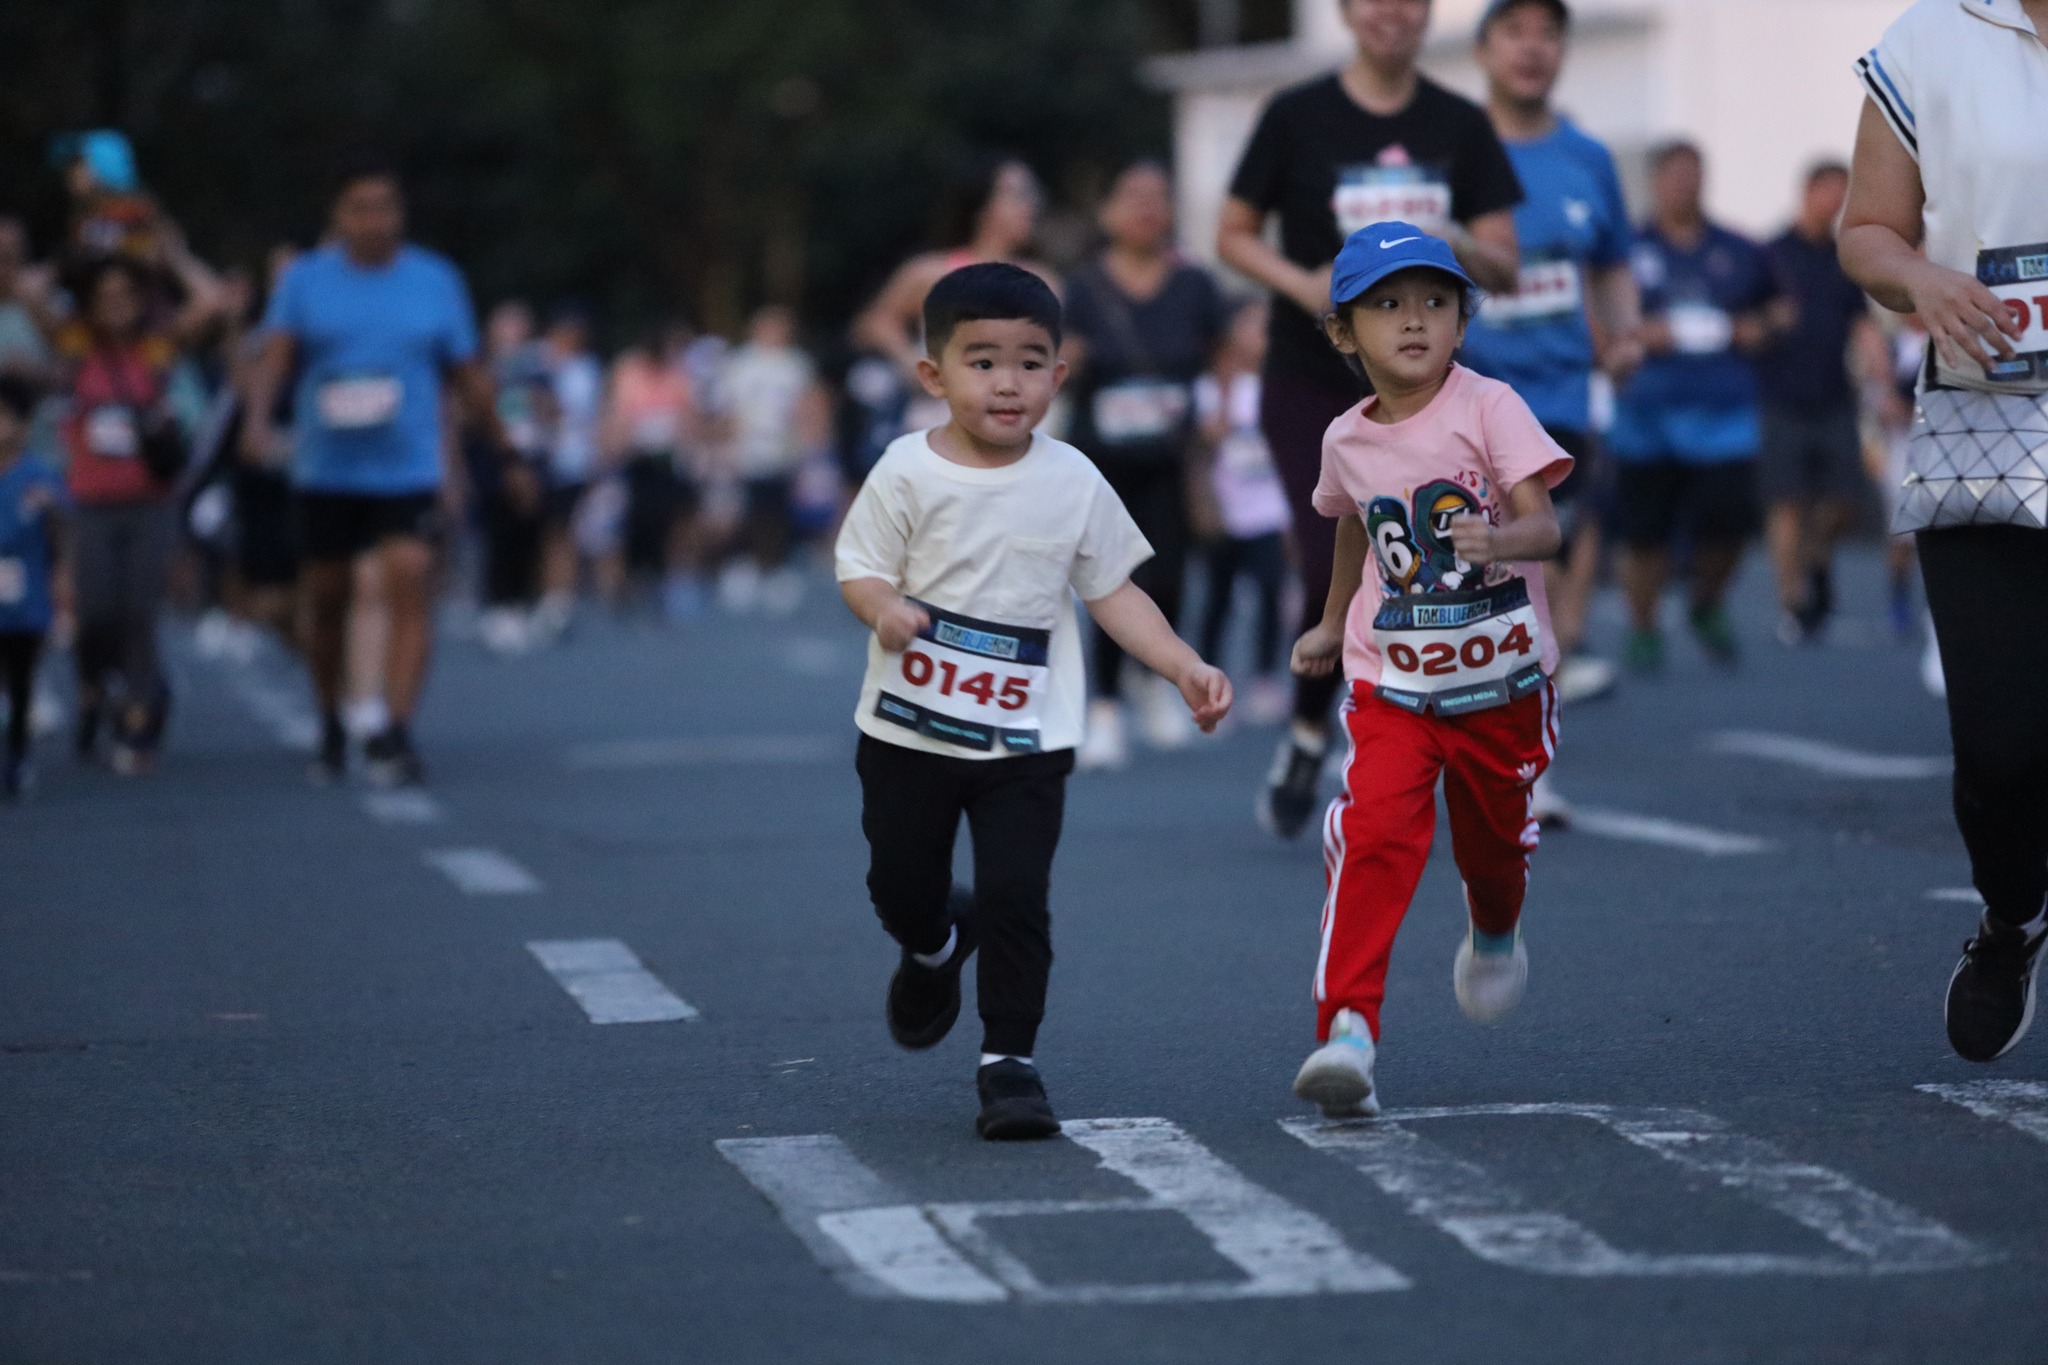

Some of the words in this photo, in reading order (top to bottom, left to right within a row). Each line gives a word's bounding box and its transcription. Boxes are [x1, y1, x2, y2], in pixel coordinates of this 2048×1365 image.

[1376, 520, 1413, 579] 6
[1387, 622, 1533, 677] 0204
[901, 650, 1032, 711] 0145
[1473, 689, 1499, 702] MEDAL
